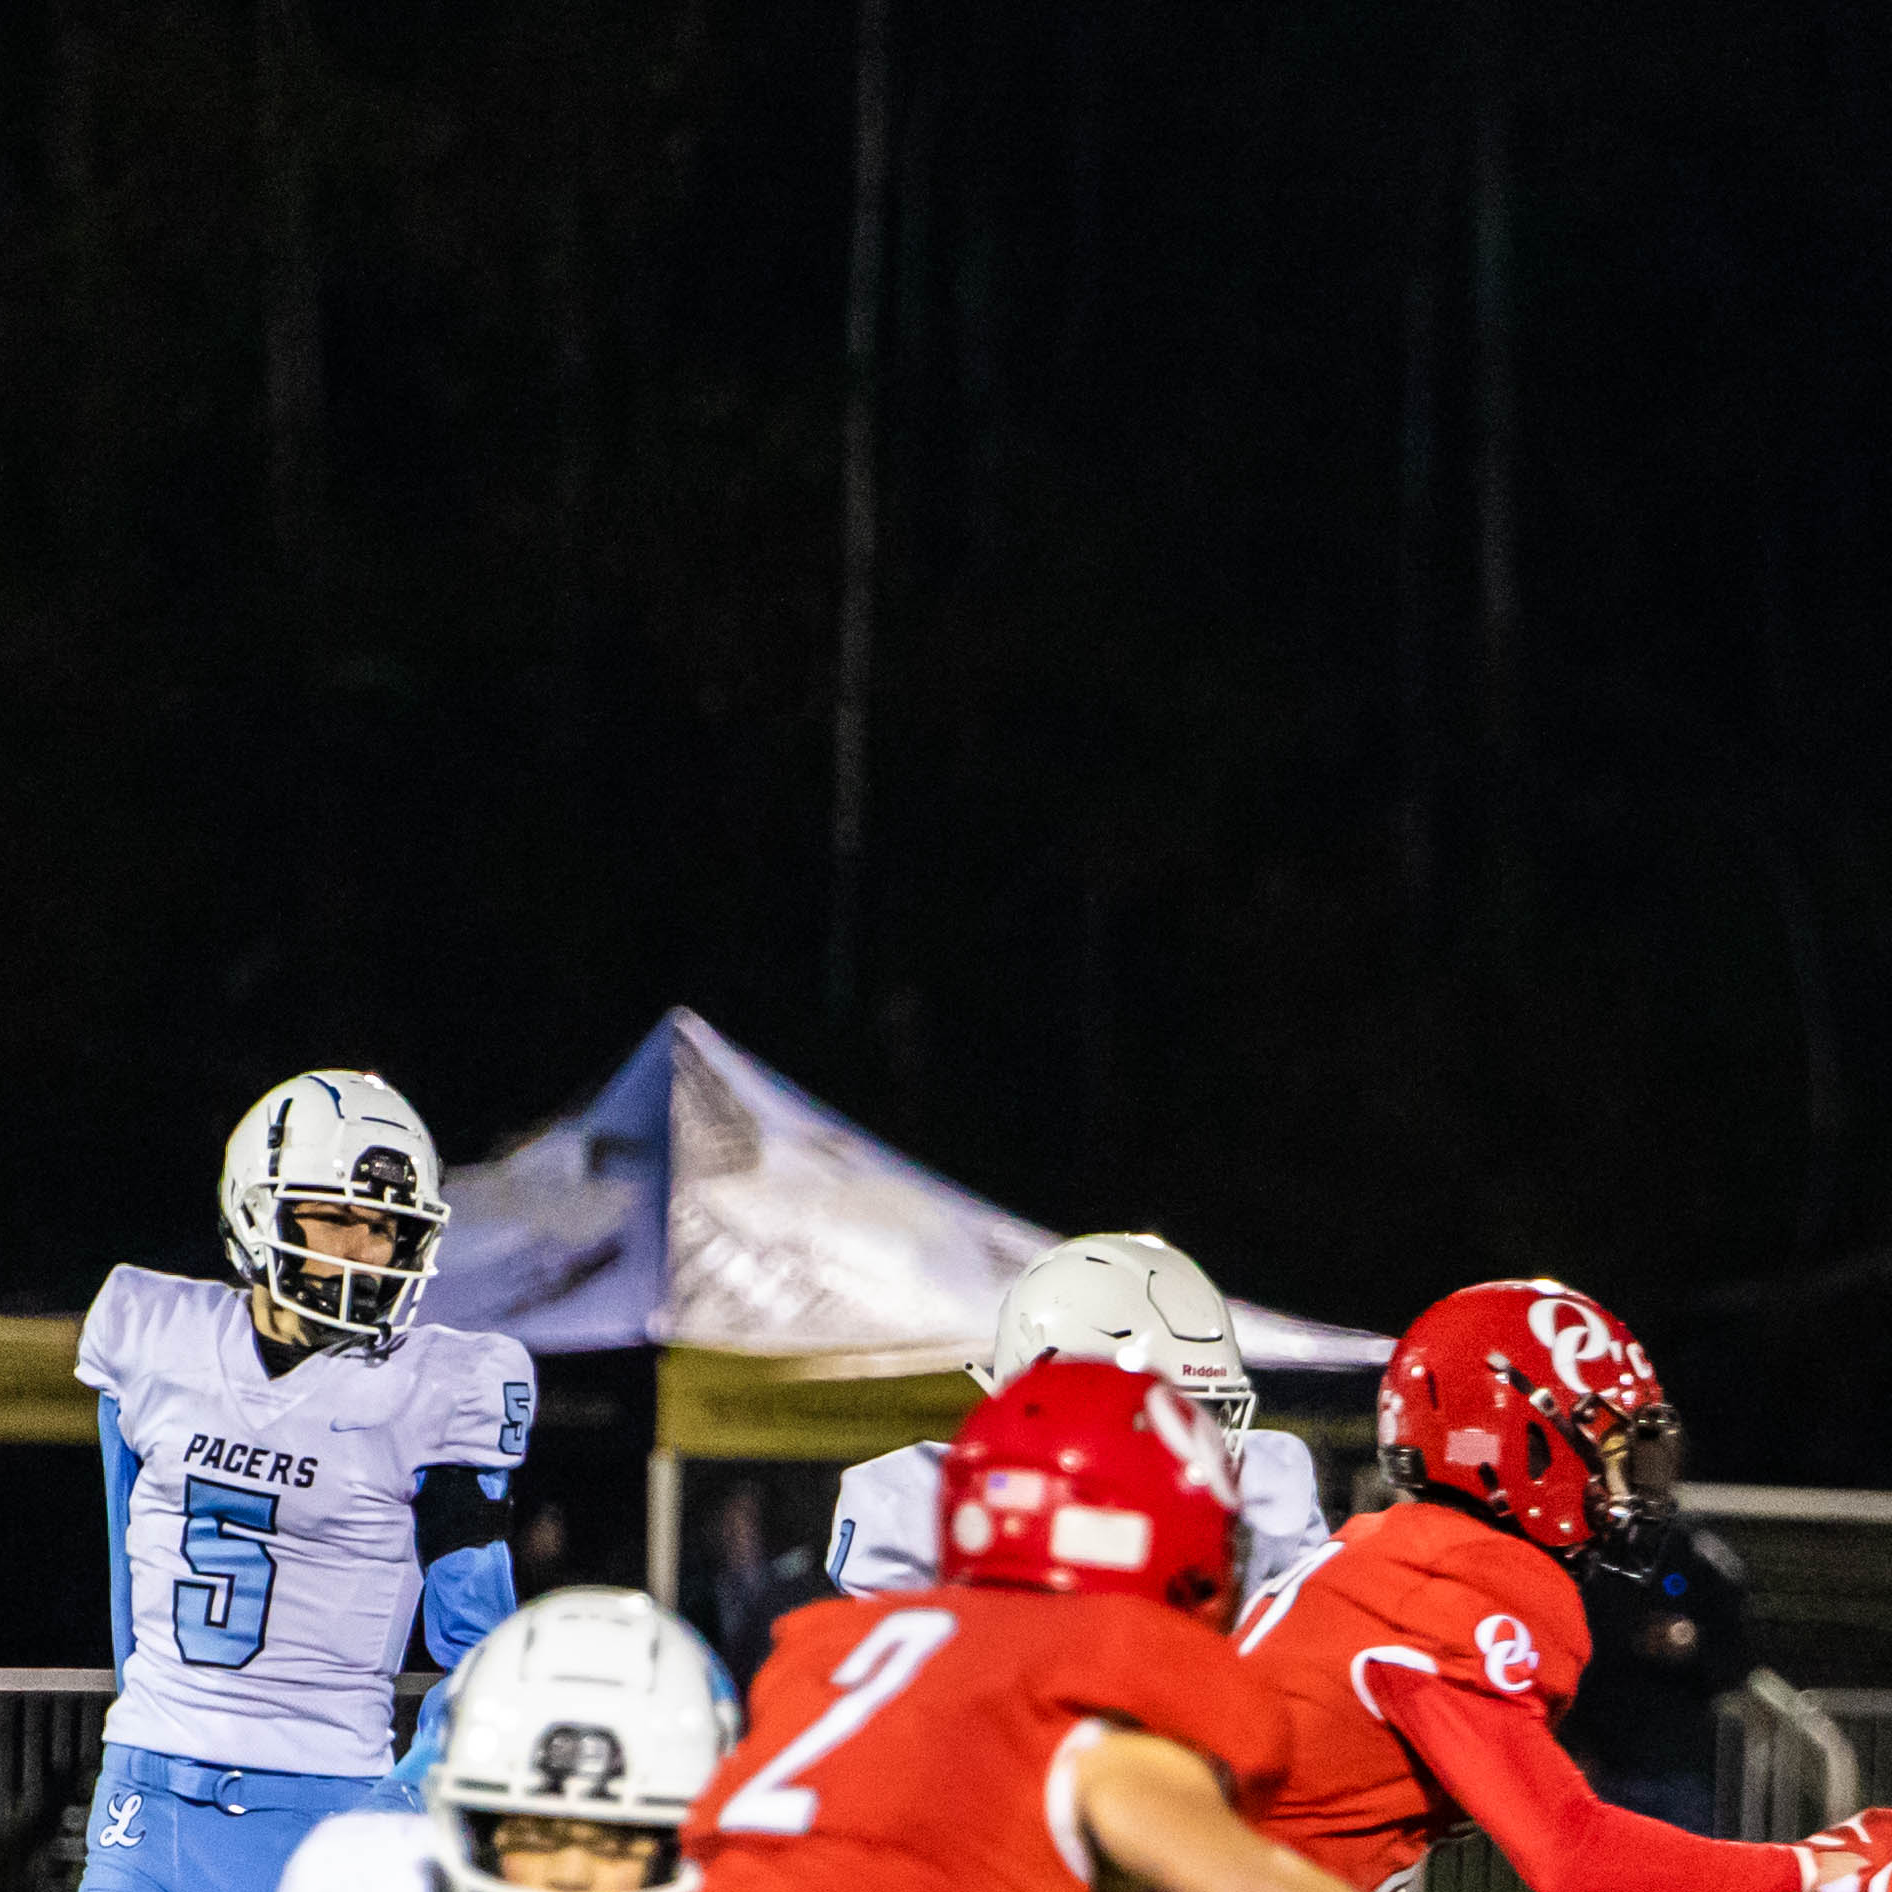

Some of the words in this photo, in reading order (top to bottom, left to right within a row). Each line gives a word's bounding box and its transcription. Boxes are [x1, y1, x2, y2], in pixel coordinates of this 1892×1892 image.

[1526, 1298, 1624, 1399] OC
[497, 1381, 533, 1455] 5
[183, 1433, 319, 1489] PACERS
[172, 1473, 281, 1670] 5
[1474, 1613, 1540, 1693] OC
[717, 1607, 958, 1836] 2
[98, 1792, 146, 1849] L
